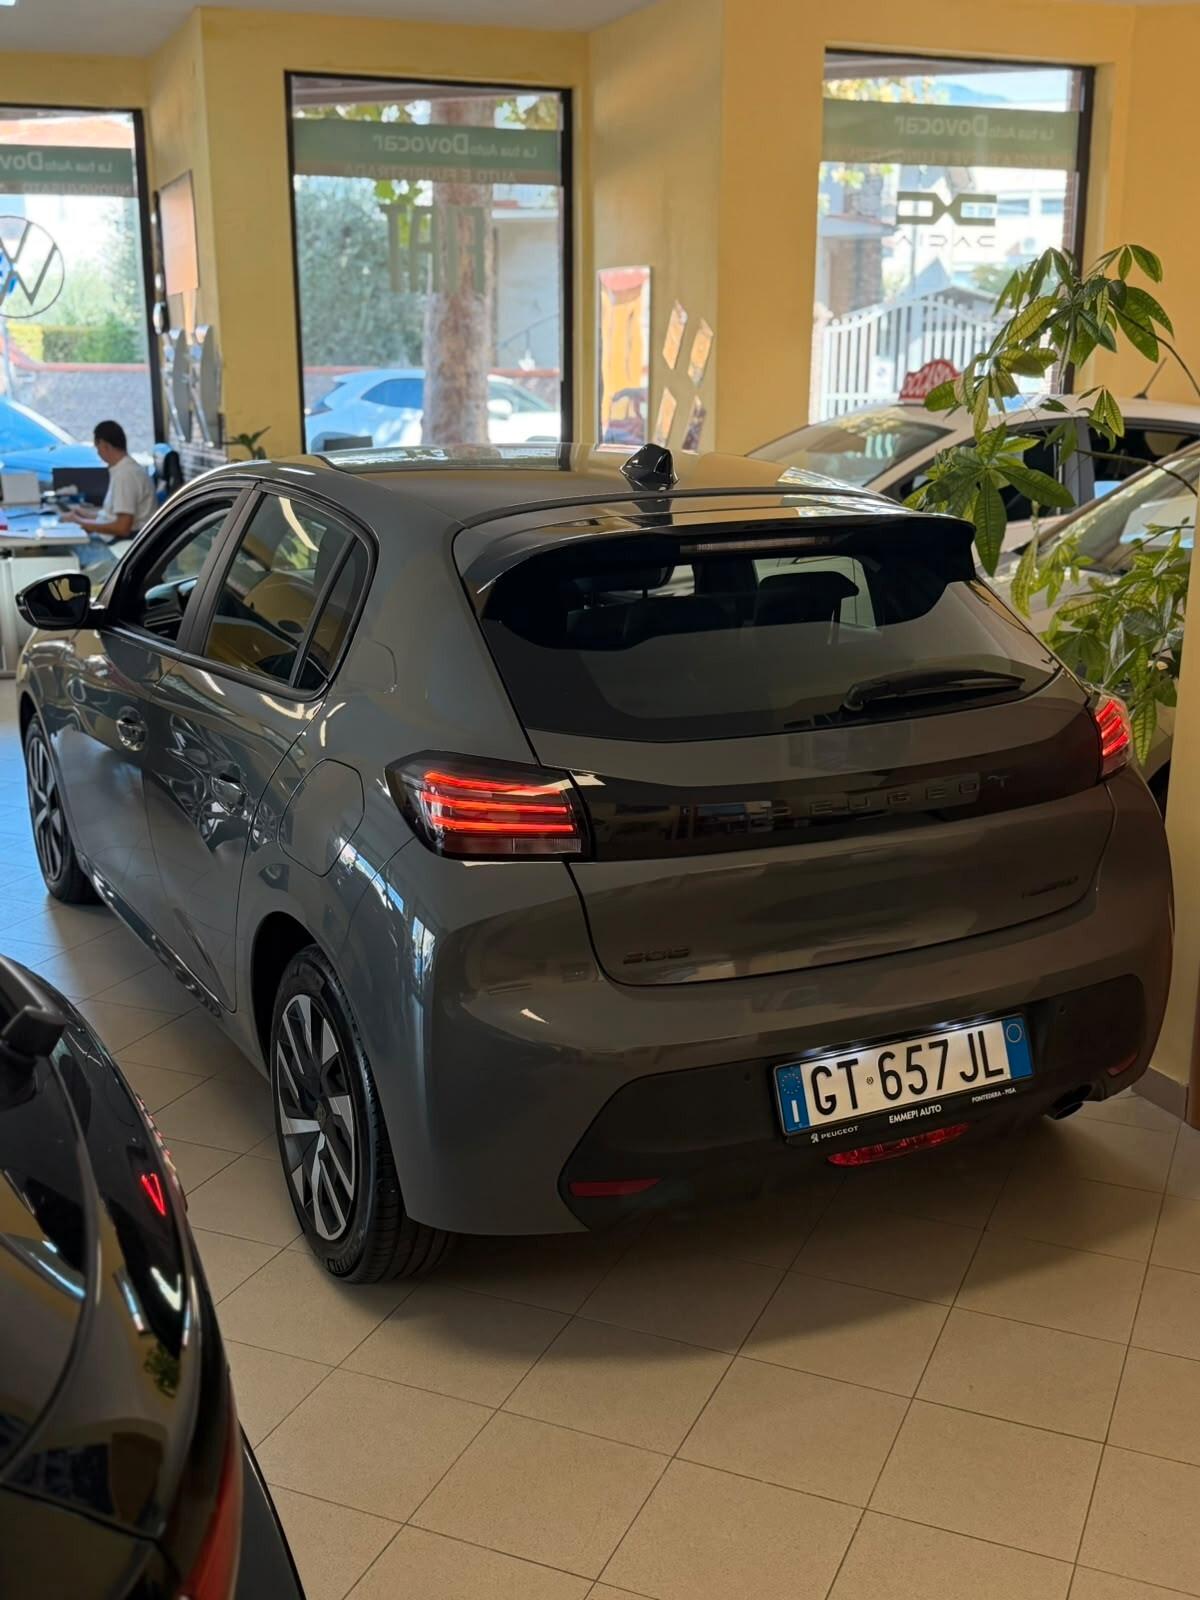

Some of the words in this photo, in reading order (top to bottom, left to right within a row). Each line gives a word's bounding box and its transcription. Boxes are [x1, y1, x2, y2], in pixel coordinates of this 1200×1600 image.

[810, 1057, 859, 1116] GT
[877, 1038, 949, 1101] 657
[959, 1030, 1005, 1083] JL
[888, 1106, 919, 1125] EMMEPI
[919, 1103, 942, 1118] AUTO
[820, 1124, 860, 1140] PEUGEOT
